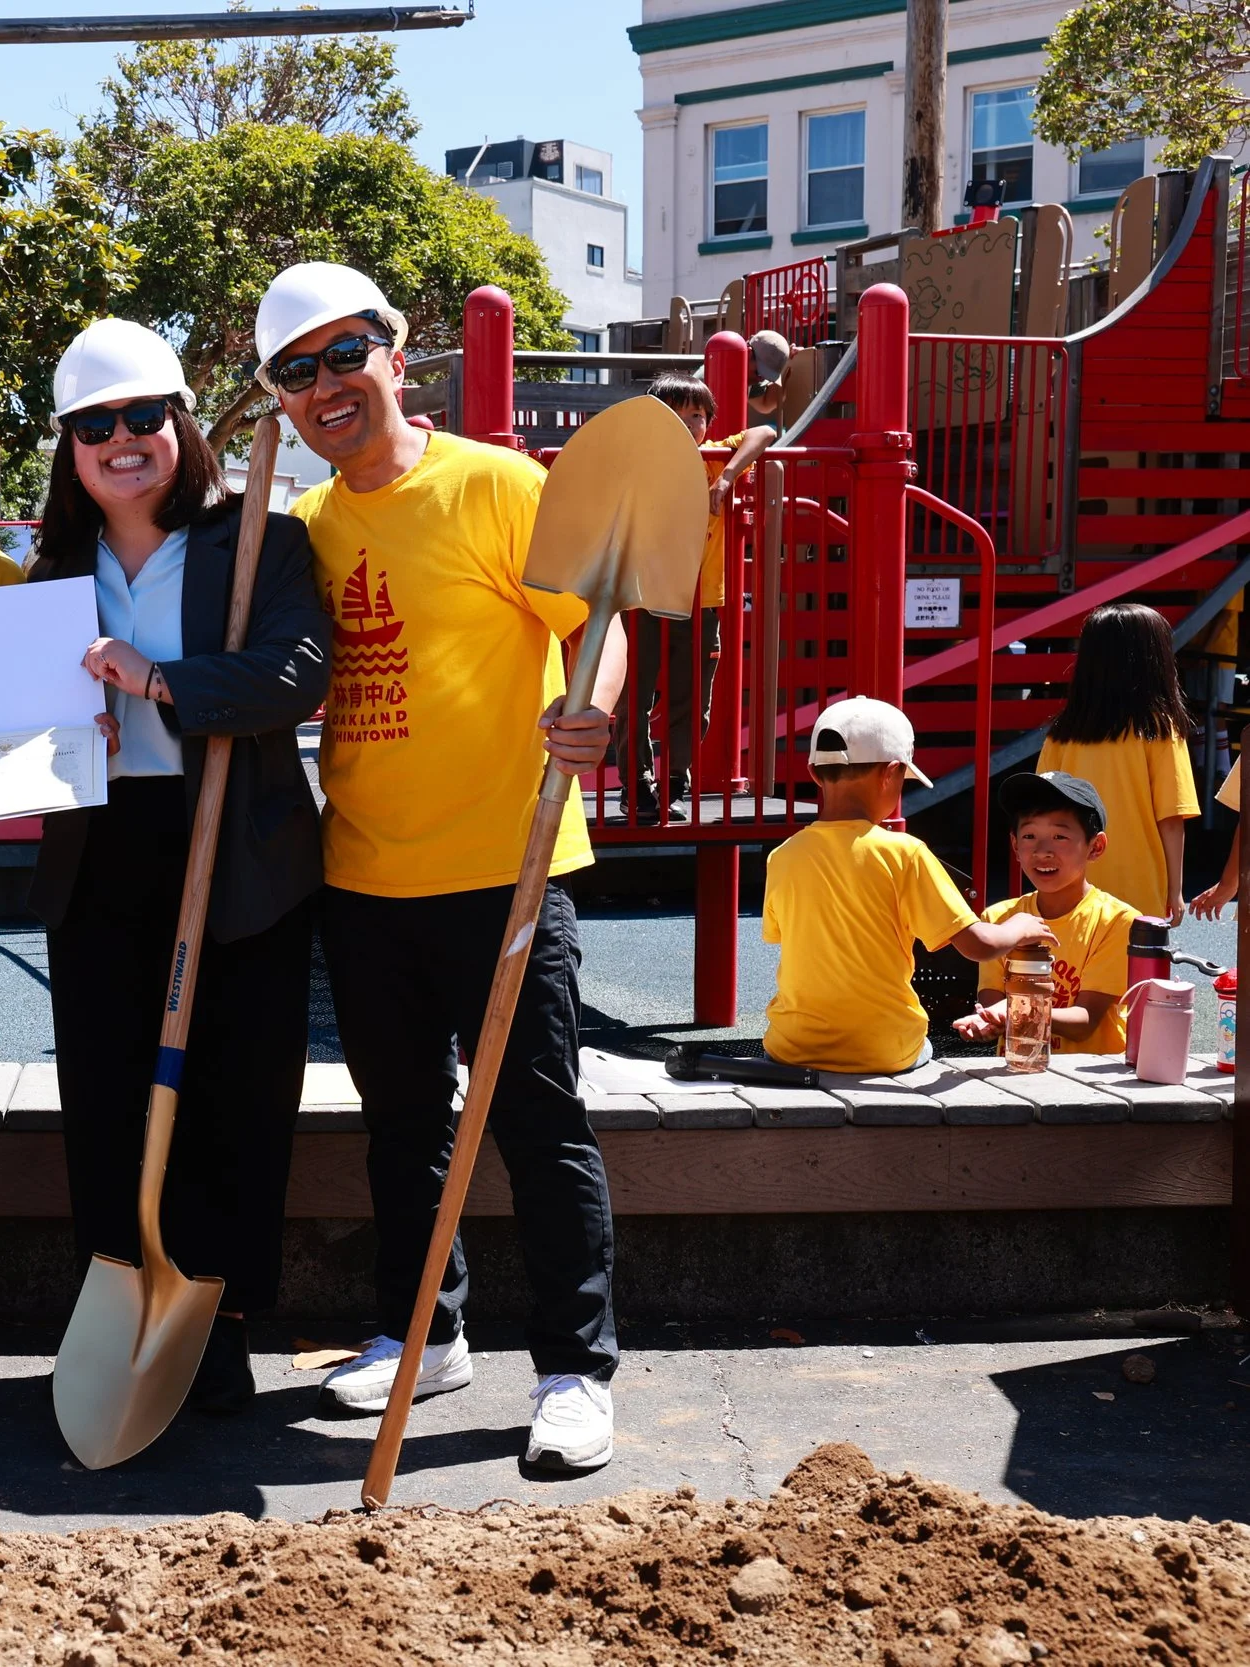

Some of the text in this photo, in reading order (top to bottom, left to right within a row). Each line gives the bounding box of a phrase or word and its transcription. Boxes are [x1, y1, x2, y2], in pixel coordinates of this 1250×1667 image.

[333, 680, 408, 709] 林肯中心
[332, 710, 408, 726] OAKLAND
[335, 726, 410, 743] HINATOWN
[167, 941, 187, 1013] WESTWARD
